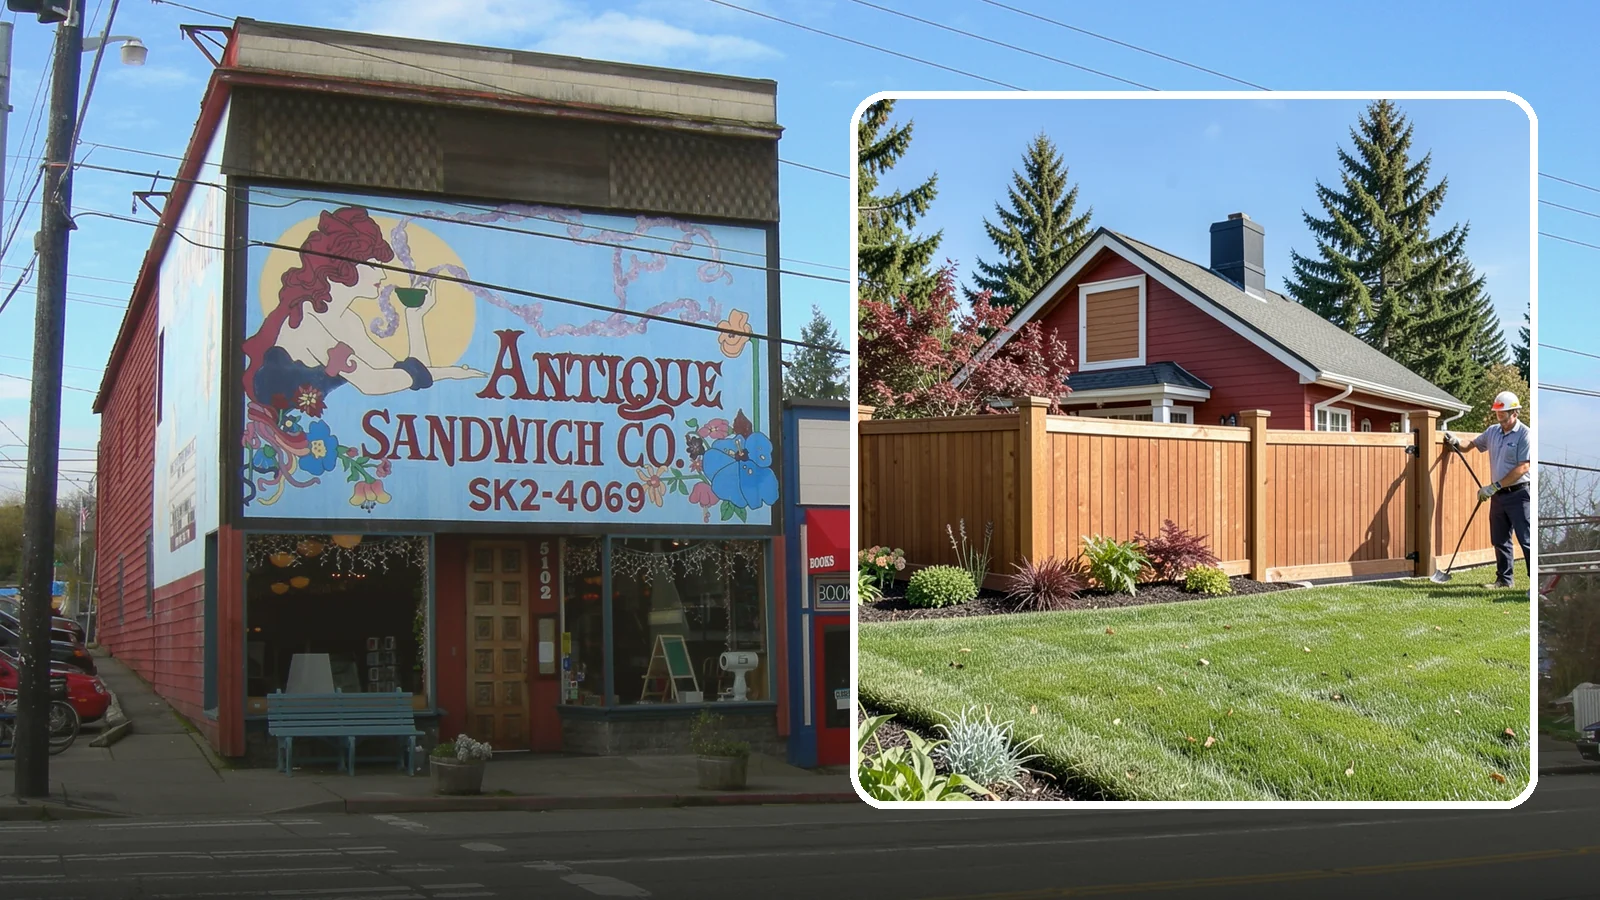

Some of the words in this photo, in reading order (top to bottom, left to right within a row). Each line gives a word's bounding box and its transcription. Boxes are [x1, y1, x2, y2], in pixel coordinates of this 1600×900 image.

[475, 329, 723, 420] ANTIQUE
[361, 409, 604, 468] SANDWICH
[617, 421, 685, 468] CO.
[468, 477, 645, 512] SK2-4069
[540, 542, 551, 600] 5102
[809, 555, 835, 569] BOOKS
